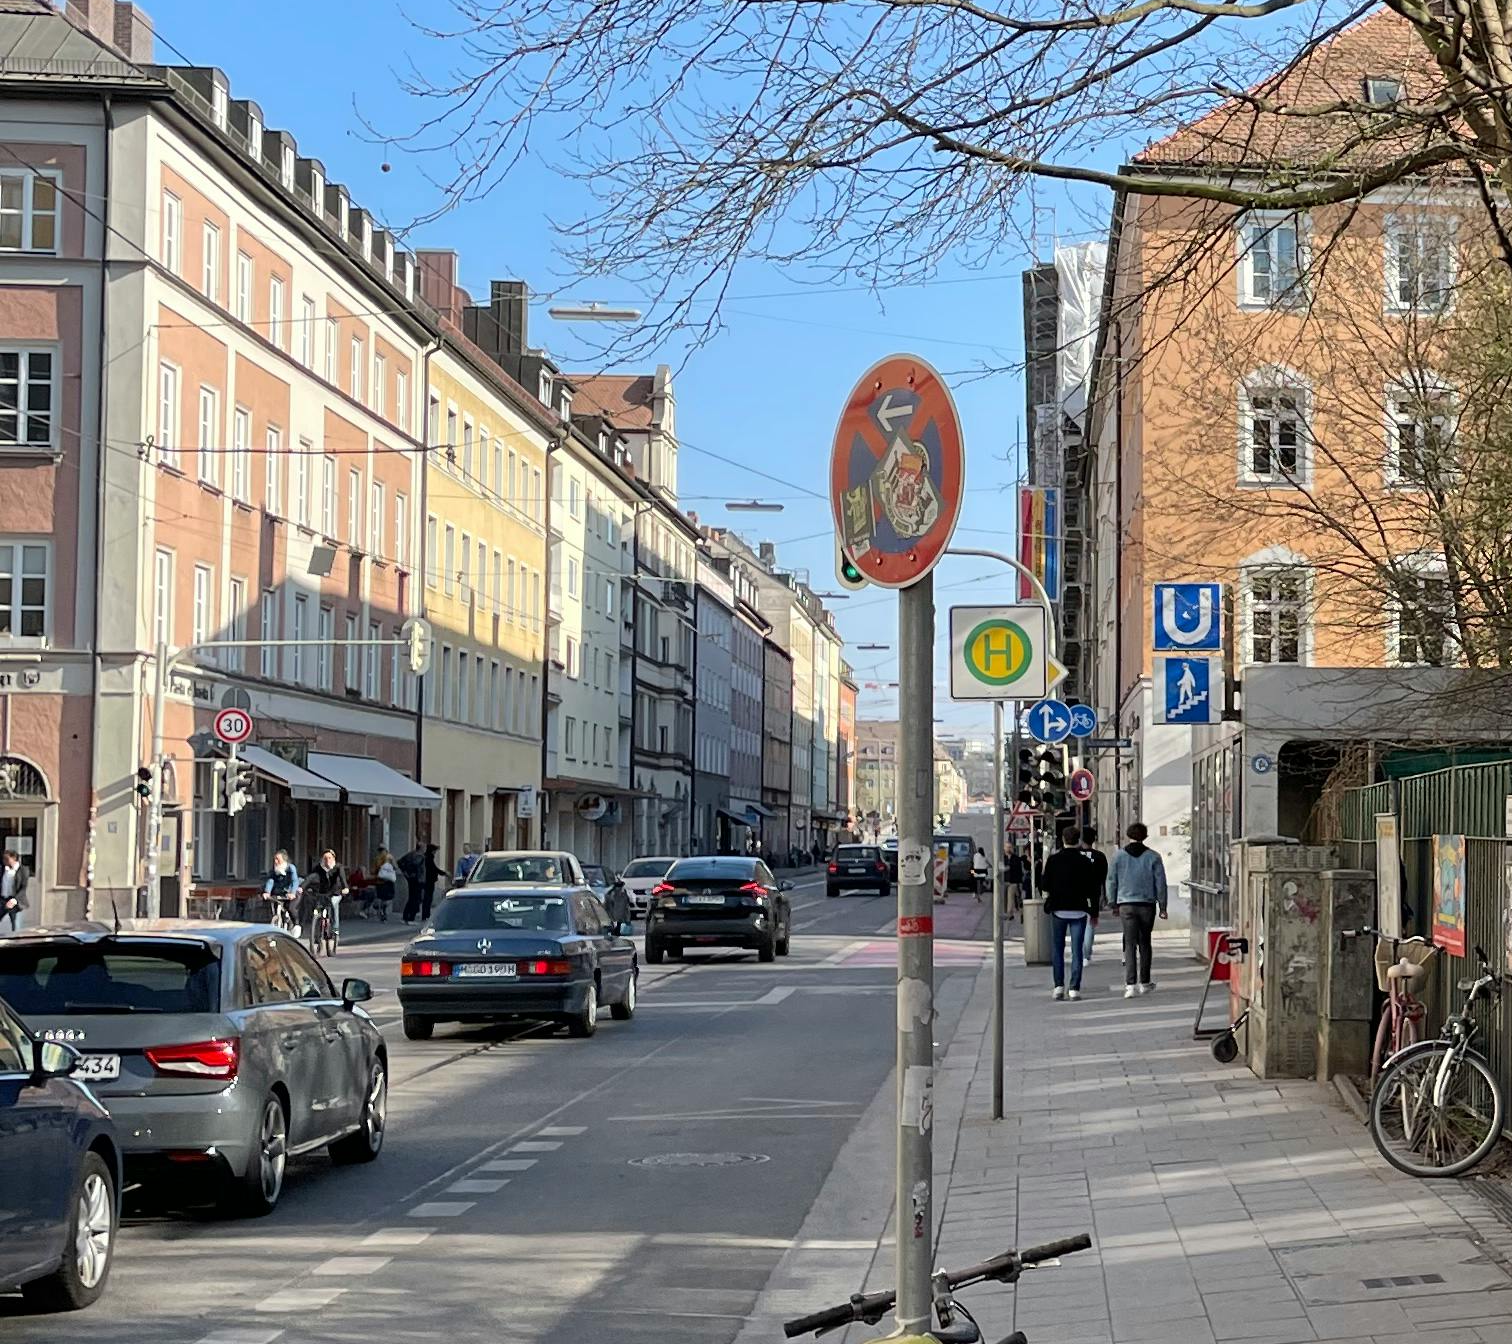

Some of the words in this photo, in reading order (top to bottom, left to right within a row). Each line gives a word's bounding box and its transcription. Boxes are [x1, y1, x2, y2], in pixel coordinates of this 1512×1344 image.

[1161, 587, 1211, 645] U
[984, 634, 1011, 671] H
[222, 718, 243, 733] 30
